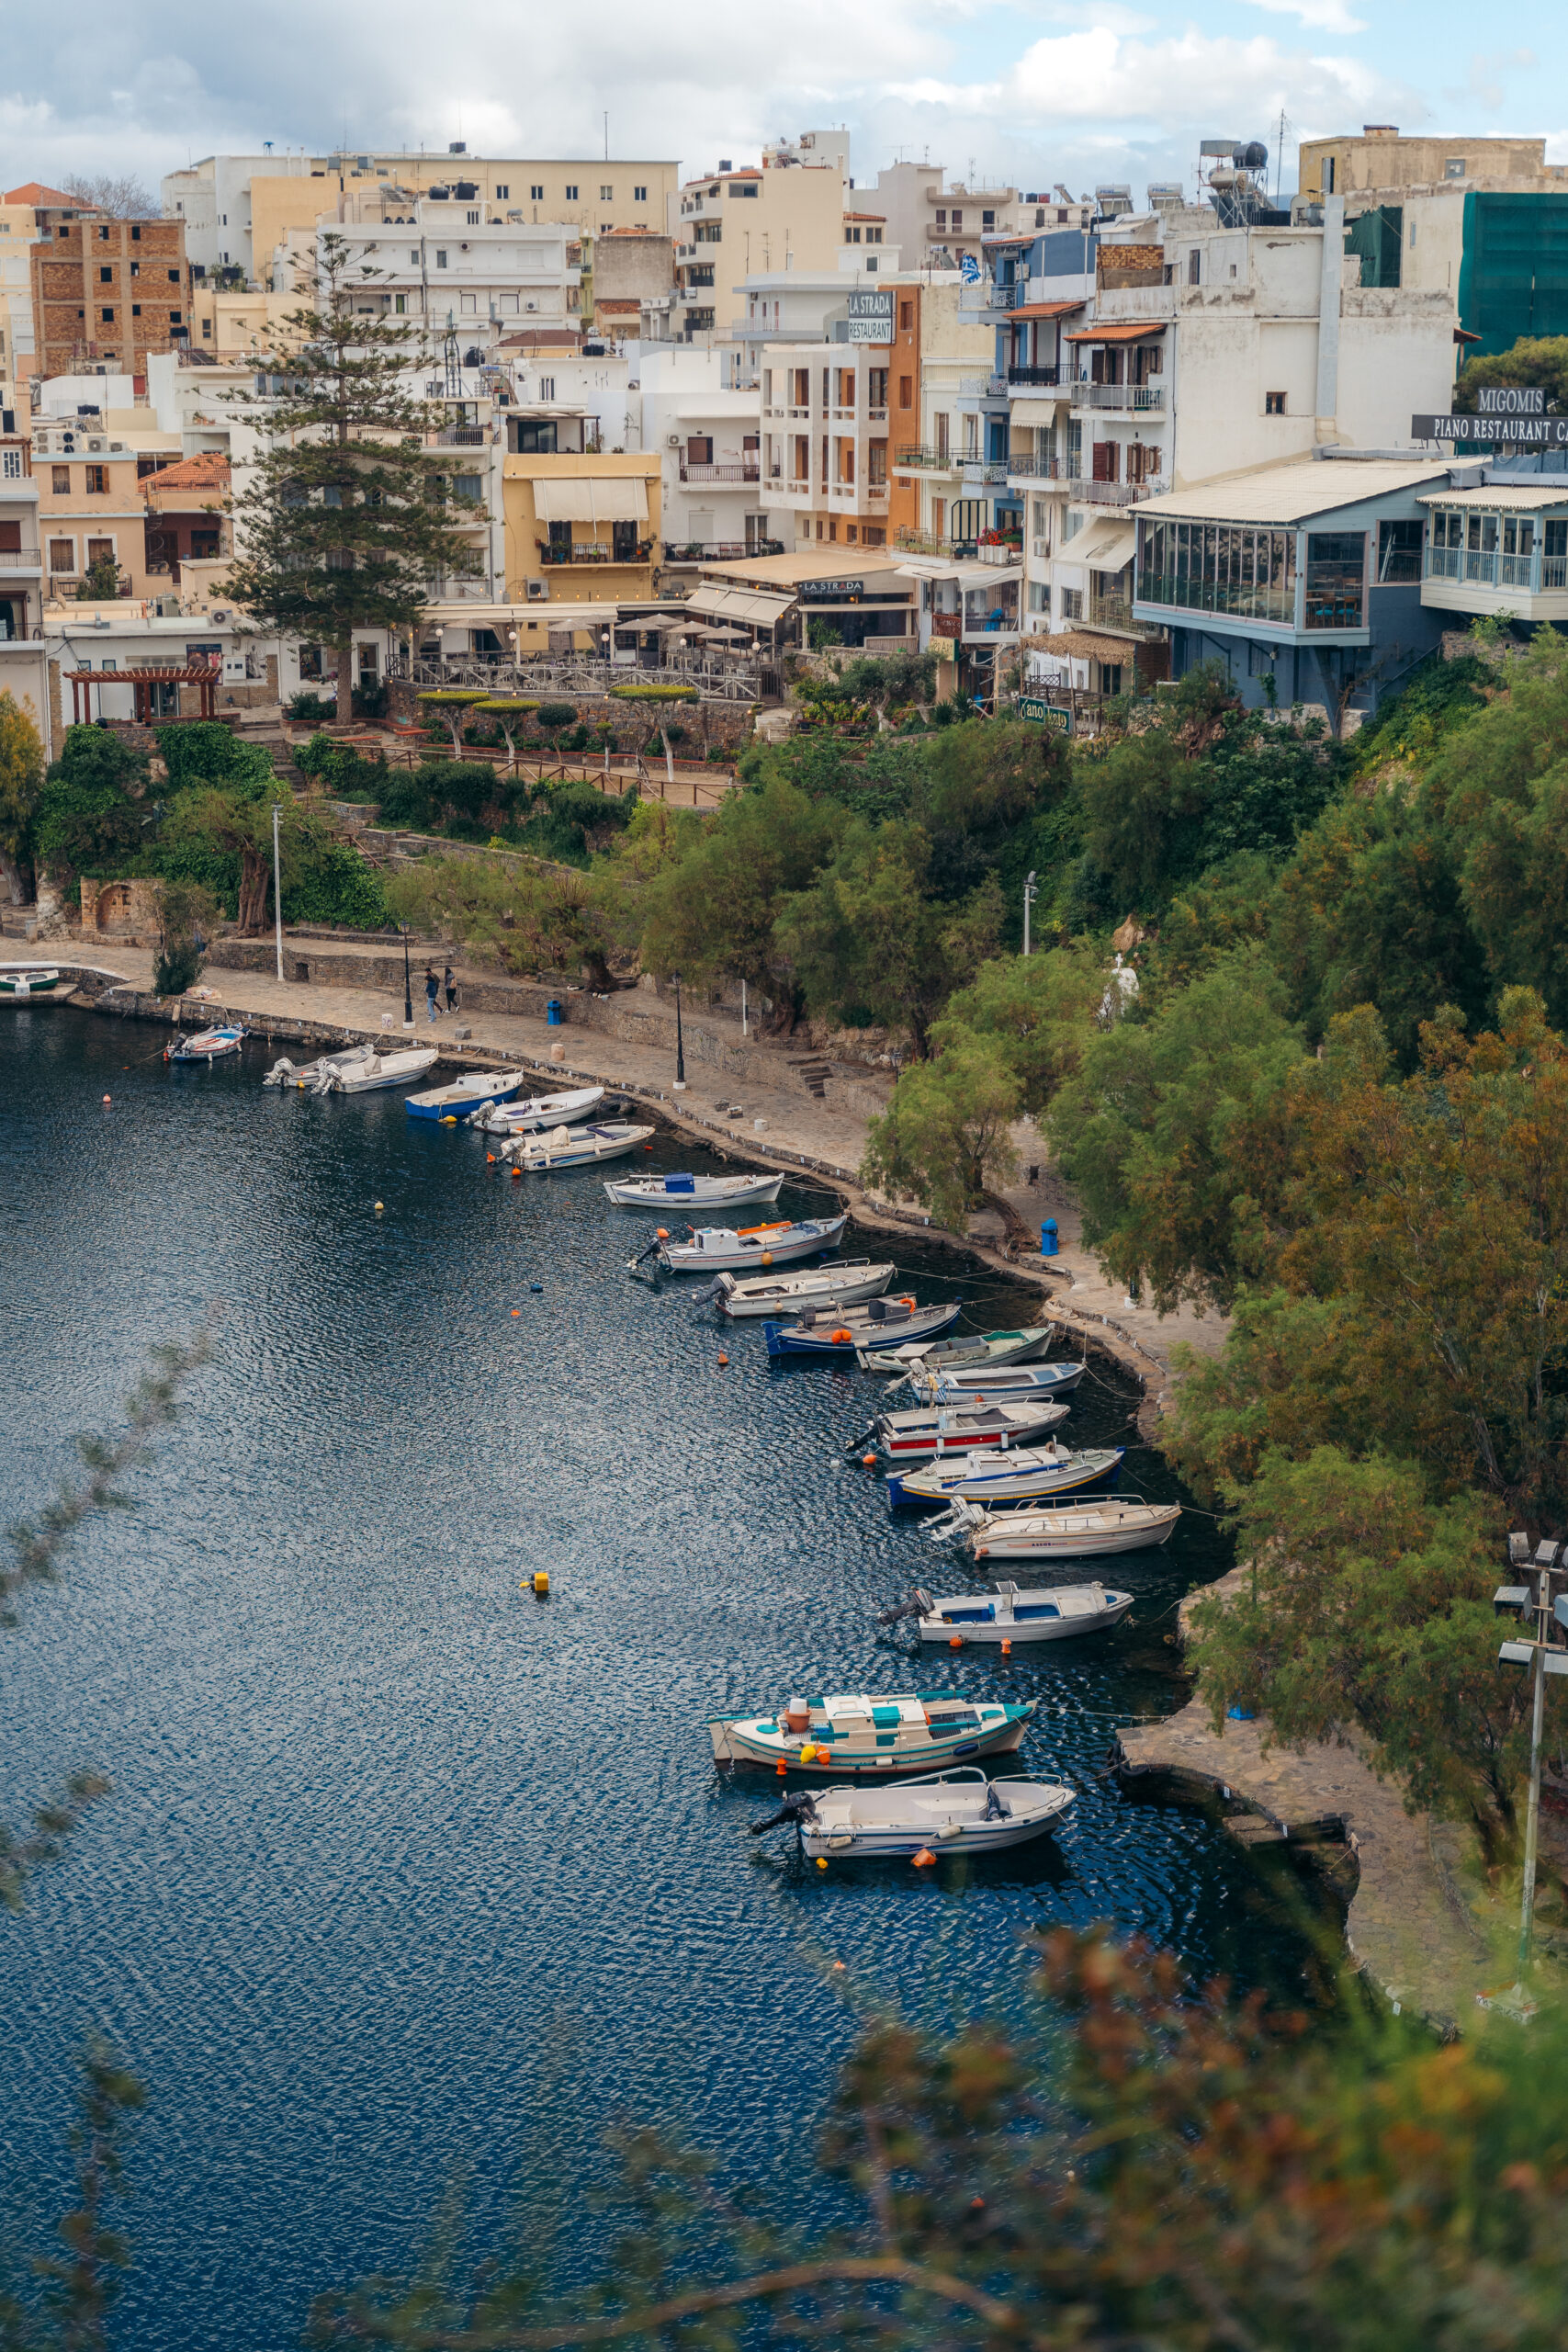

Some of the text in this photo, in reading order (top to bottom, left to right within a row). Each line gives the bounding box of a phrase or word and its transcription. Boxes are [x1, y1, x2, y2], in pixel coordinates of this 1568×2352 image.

[849, 295, 891, 314] LA STRADA
[849, 322, 891, 339] RESTAURANT
[1479, 390, 1543, 413] MIGOMIS
[1434, 418, 1469, 438] PIANO
[1473, 419, 1551, 441] RESTAURANT
[805, 582, 862, 591] LA STRADA
